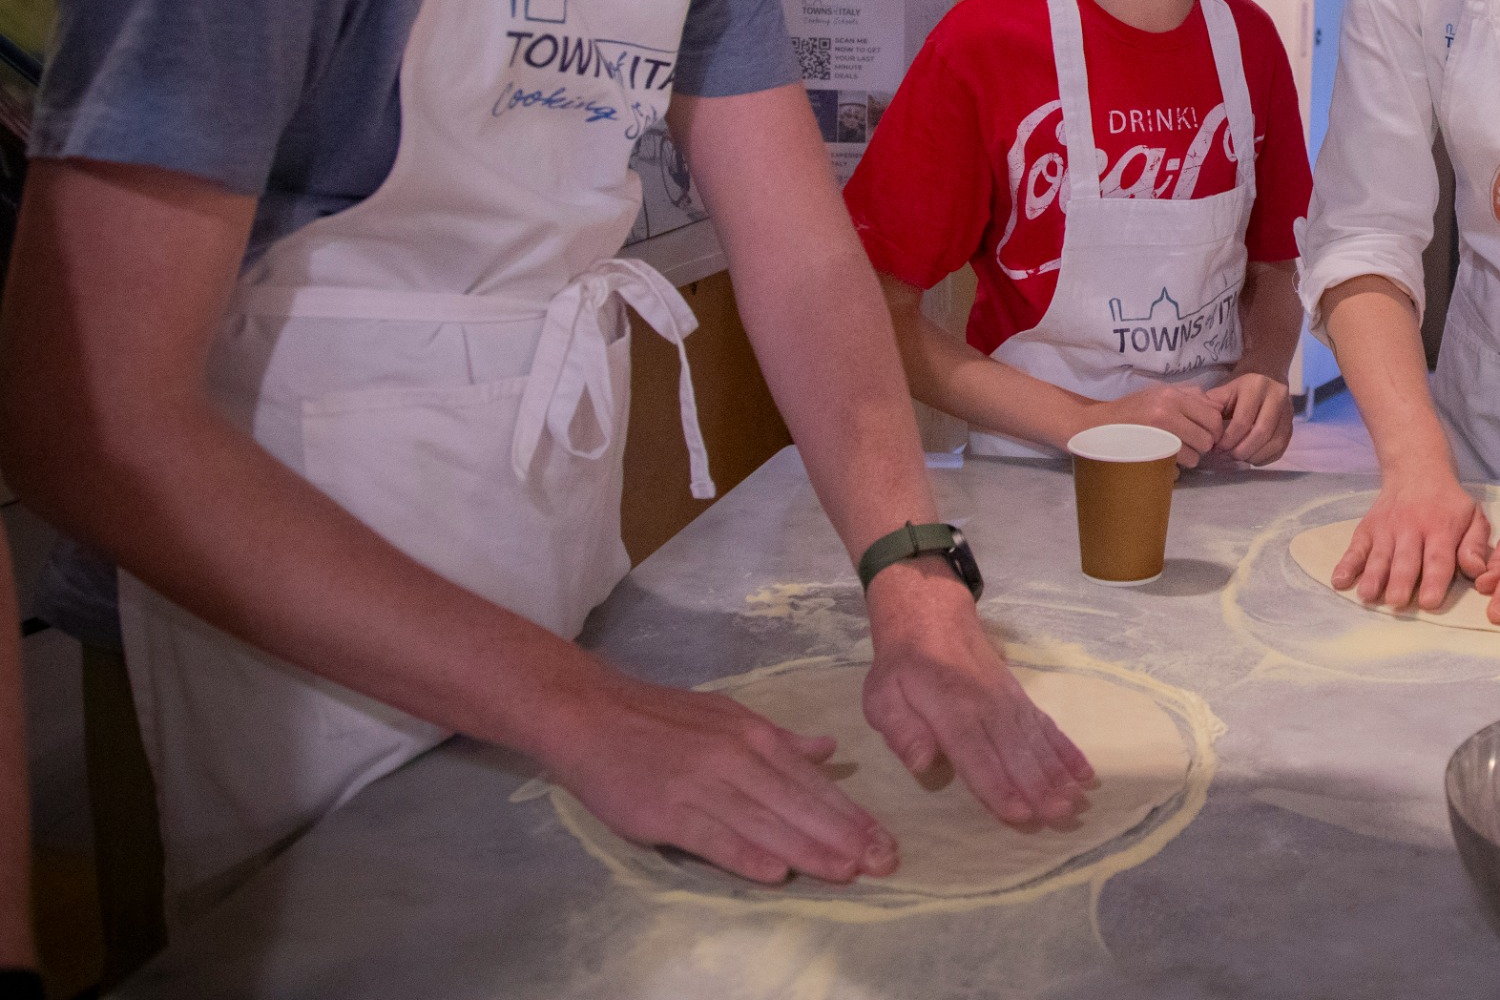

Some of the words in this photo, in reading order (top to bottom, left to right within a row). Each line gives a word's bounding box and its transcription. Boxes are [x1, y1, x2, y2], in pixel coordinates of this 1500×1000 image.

[802, 6, 833, 16] TOWNS
[839, 8, 861, 17] ITALY
[1108, 105, 1199, 134] DRINK!
[1113, 315, 1204, 353] TOWNS
